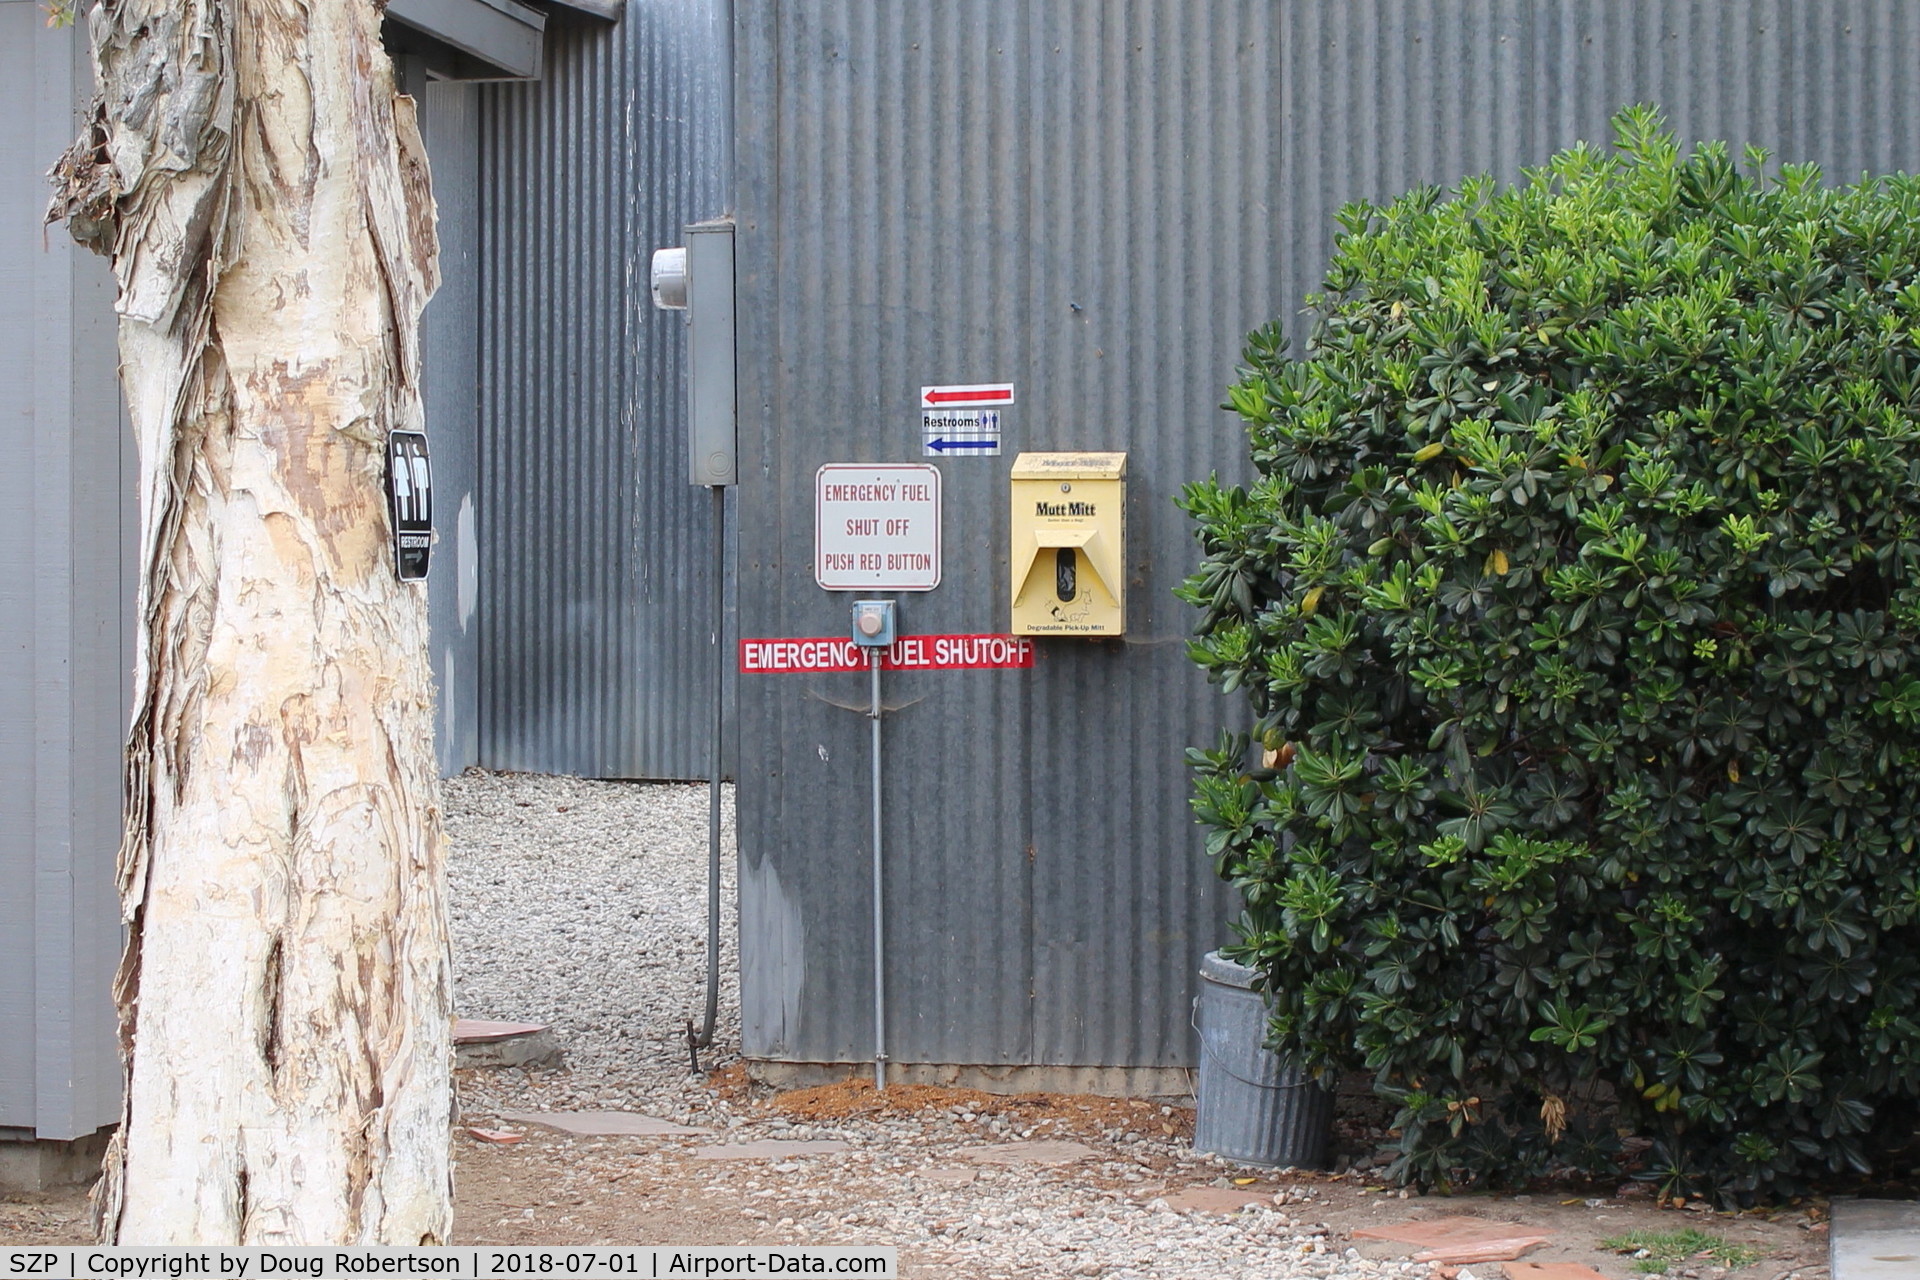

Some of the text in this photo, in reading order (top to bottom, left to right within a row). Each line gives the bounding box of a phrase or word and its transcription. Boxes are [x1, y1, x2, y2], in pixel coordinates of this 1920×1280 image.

[923, 416, 980, 428] Restrooms
[825, 485, 931, 501] EMERGENCY FUEL
[1035, 502, 1096, 516] Mutt Mitt
[846, 519, 910, 536] SHUT OFF
[401, 536, 429, 548] RESTROOM
[825, 554, 931, 570] PUSH RED BUTTON
[745, 641, 869, 668] EMERGENCY
[935, 638, 1030, 665] SHUTOFF
